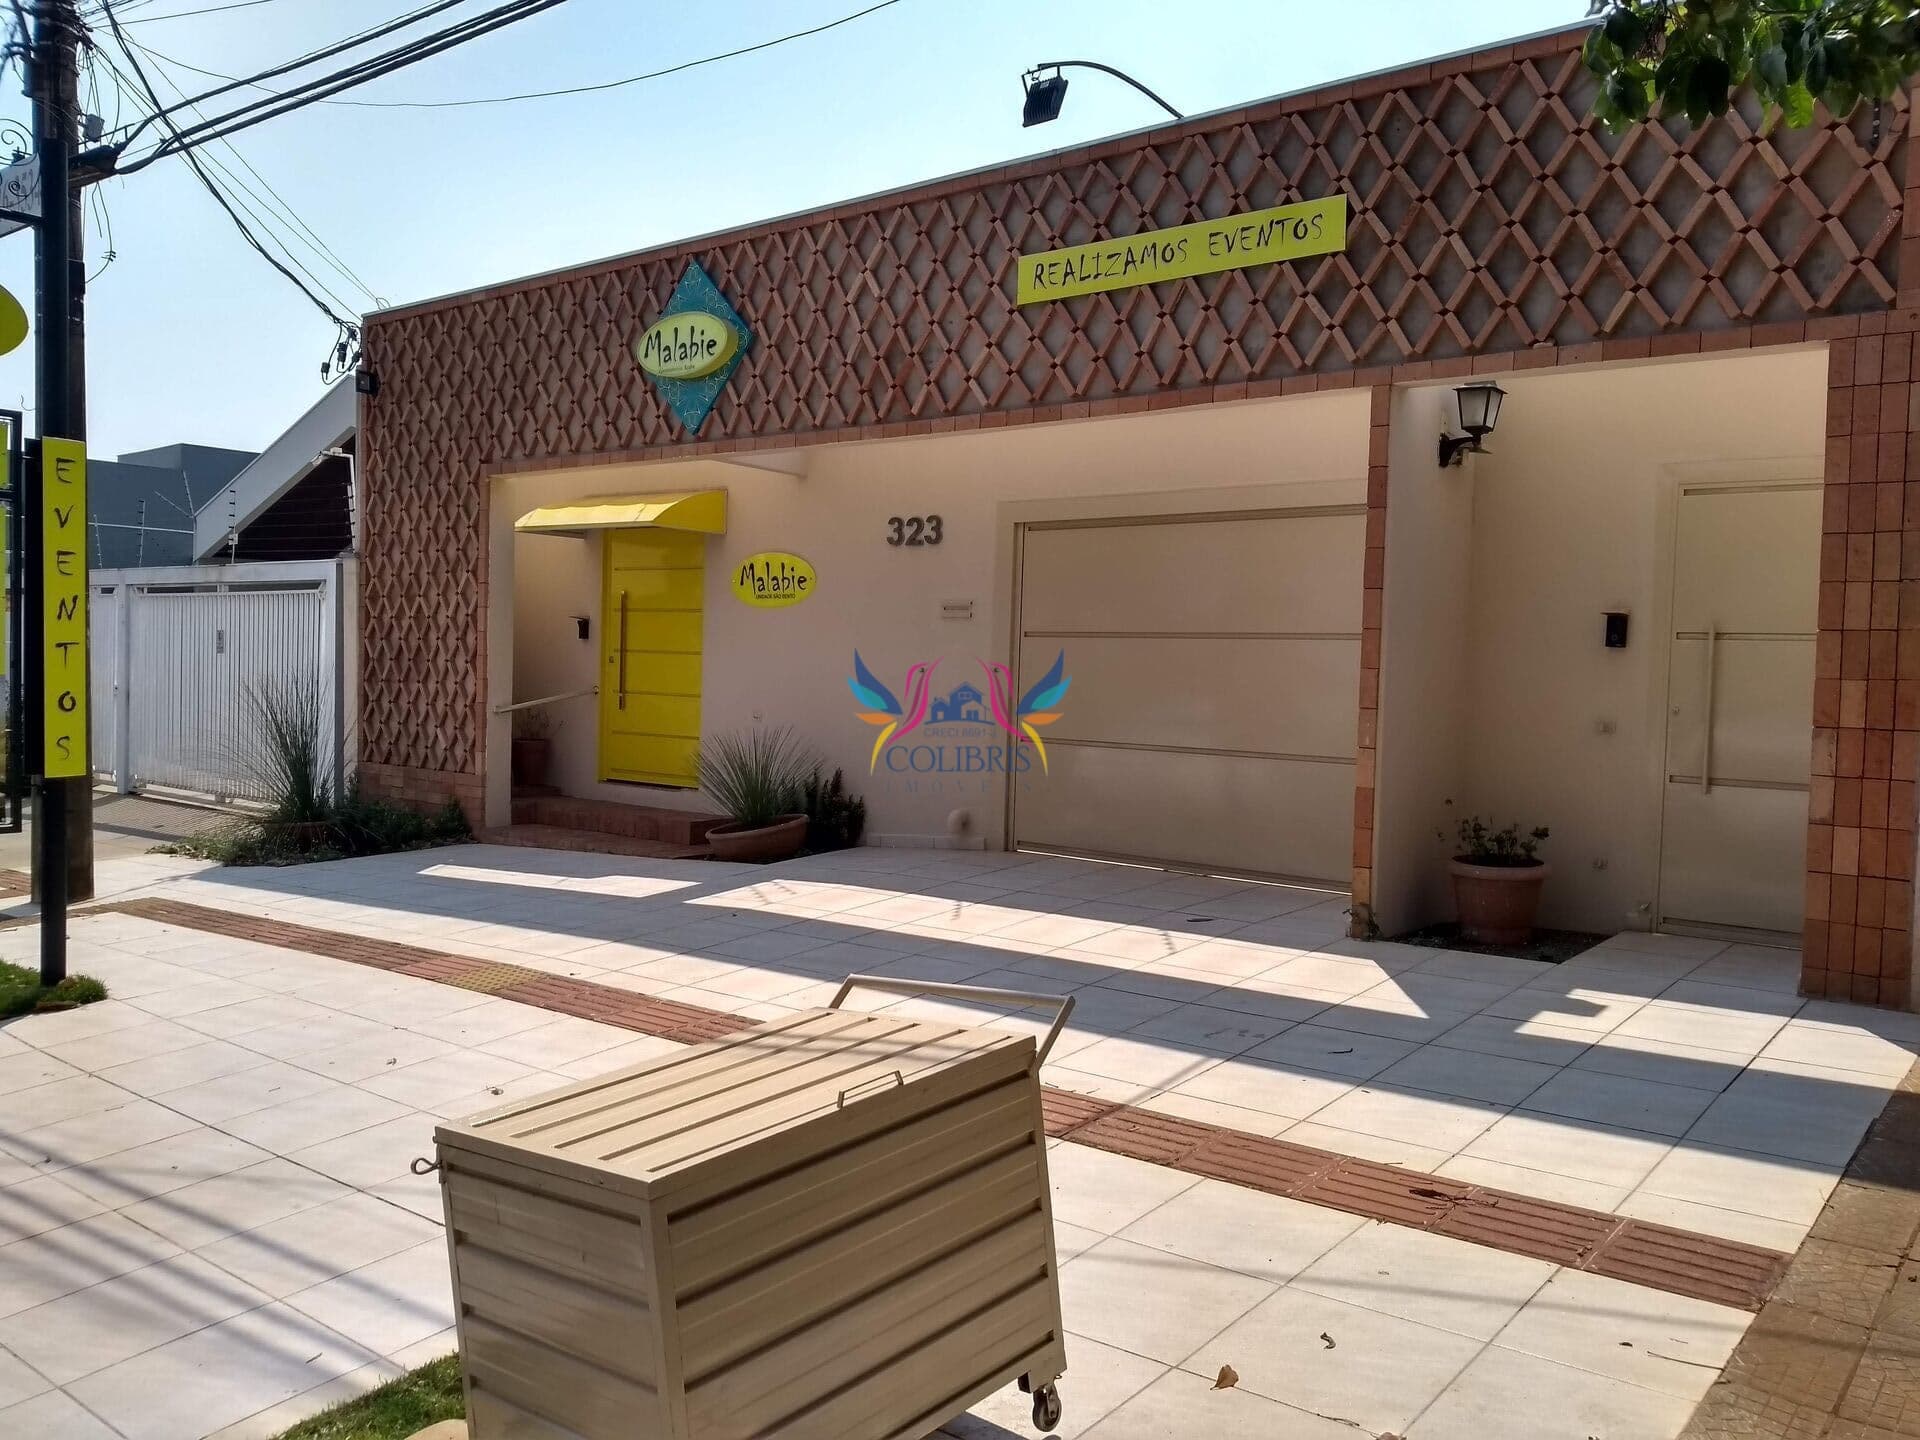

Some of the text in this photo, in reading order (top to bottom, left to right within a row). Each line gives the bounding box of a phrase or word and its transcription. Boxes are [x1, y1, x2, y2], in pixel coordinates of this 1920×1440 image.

[1033, 213, 1323, 289] REALIZAMOS EVENTOS
[643, 325, 718, 368] Malabie
[886, 515, 944, 546] 323
[740, 561, 808, 595] Malabie
[54, 456, 79, 761] EVENTOS
